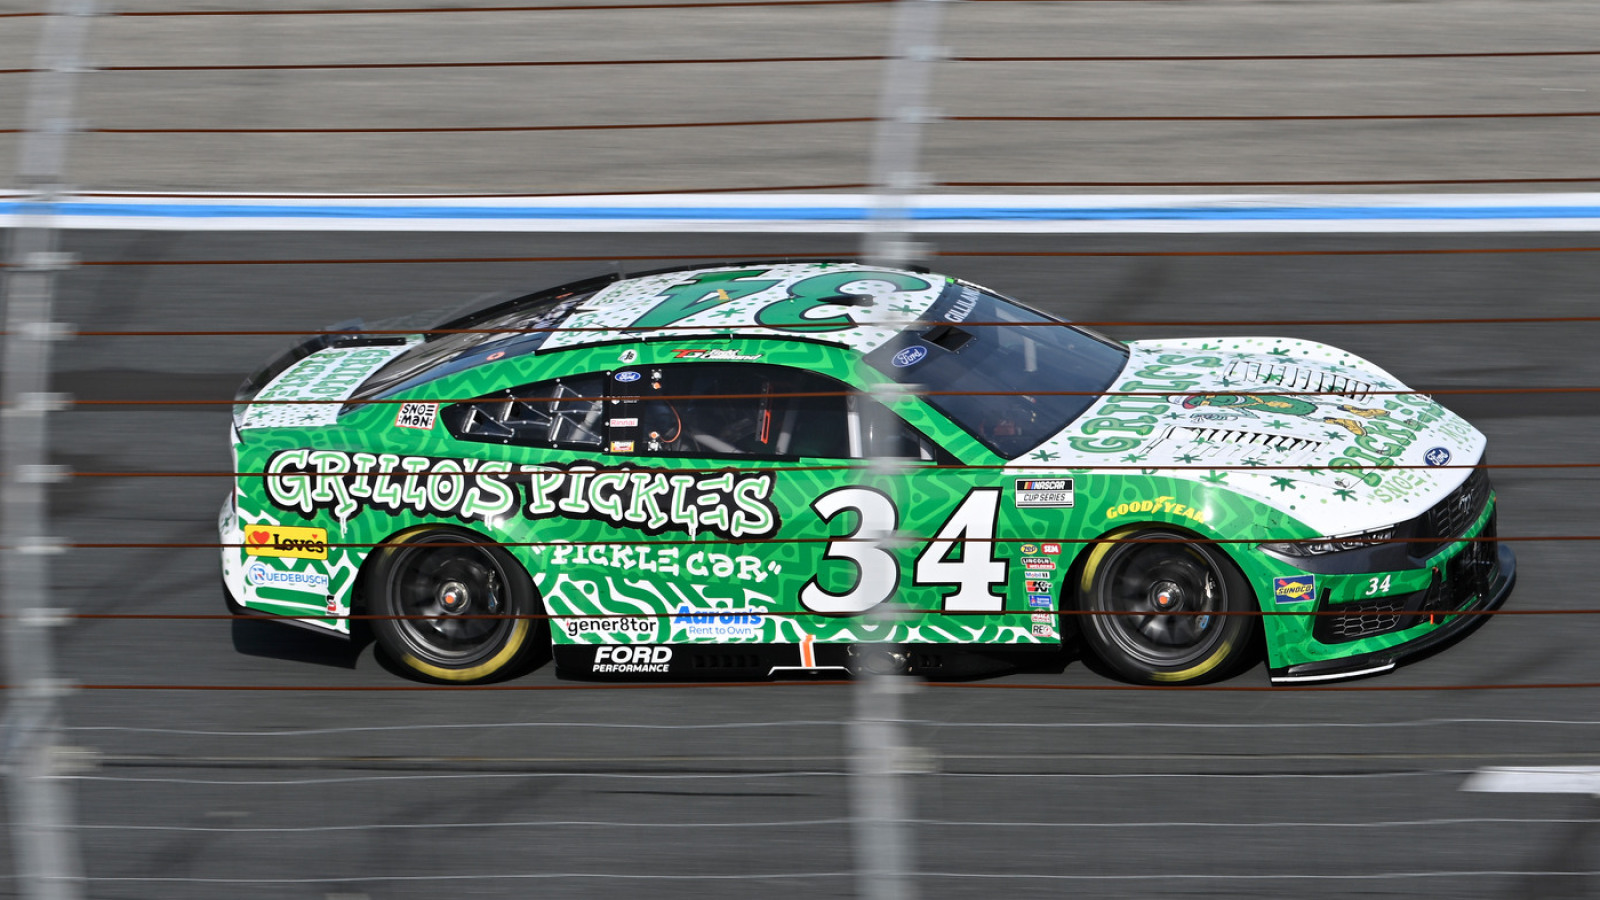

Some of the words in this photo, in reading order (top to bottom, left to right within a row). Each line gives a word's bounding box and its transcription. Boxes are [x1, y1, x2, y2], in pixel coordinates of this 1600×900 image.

[895, 347, 924, 365] Ford
[1426, 449, 1448, 465] Ford
[267, 449, 513, 530] GRILLO'S
[519, 464, 773, 538] PICKLES
[1033, 481, 1066, 490] NASCAR
[1023, 493, 1039, 502] CUP
[1039, 493, 1066, 502] SERIES
[1106, 496, 1206, 524] GOODYEAR
[798, 485, 1010, 617] 34
[251, 566, 329, 586] RUEDEBUSCH
[1277, 584, 1313, 597] SUNOCO
[1365, 575, 1392, 596] 34
[673, 606, 763, 625] Aaron's
[567, 618, 657, 637] gener8tor
[688, 626, 713, 635] Rent
[714, 626, 726, 635] to
[726, 626, 753, 635] Own
[593, 646, 673, 664] FORD
[592, 664, 670, 673] PERFORMANCE
